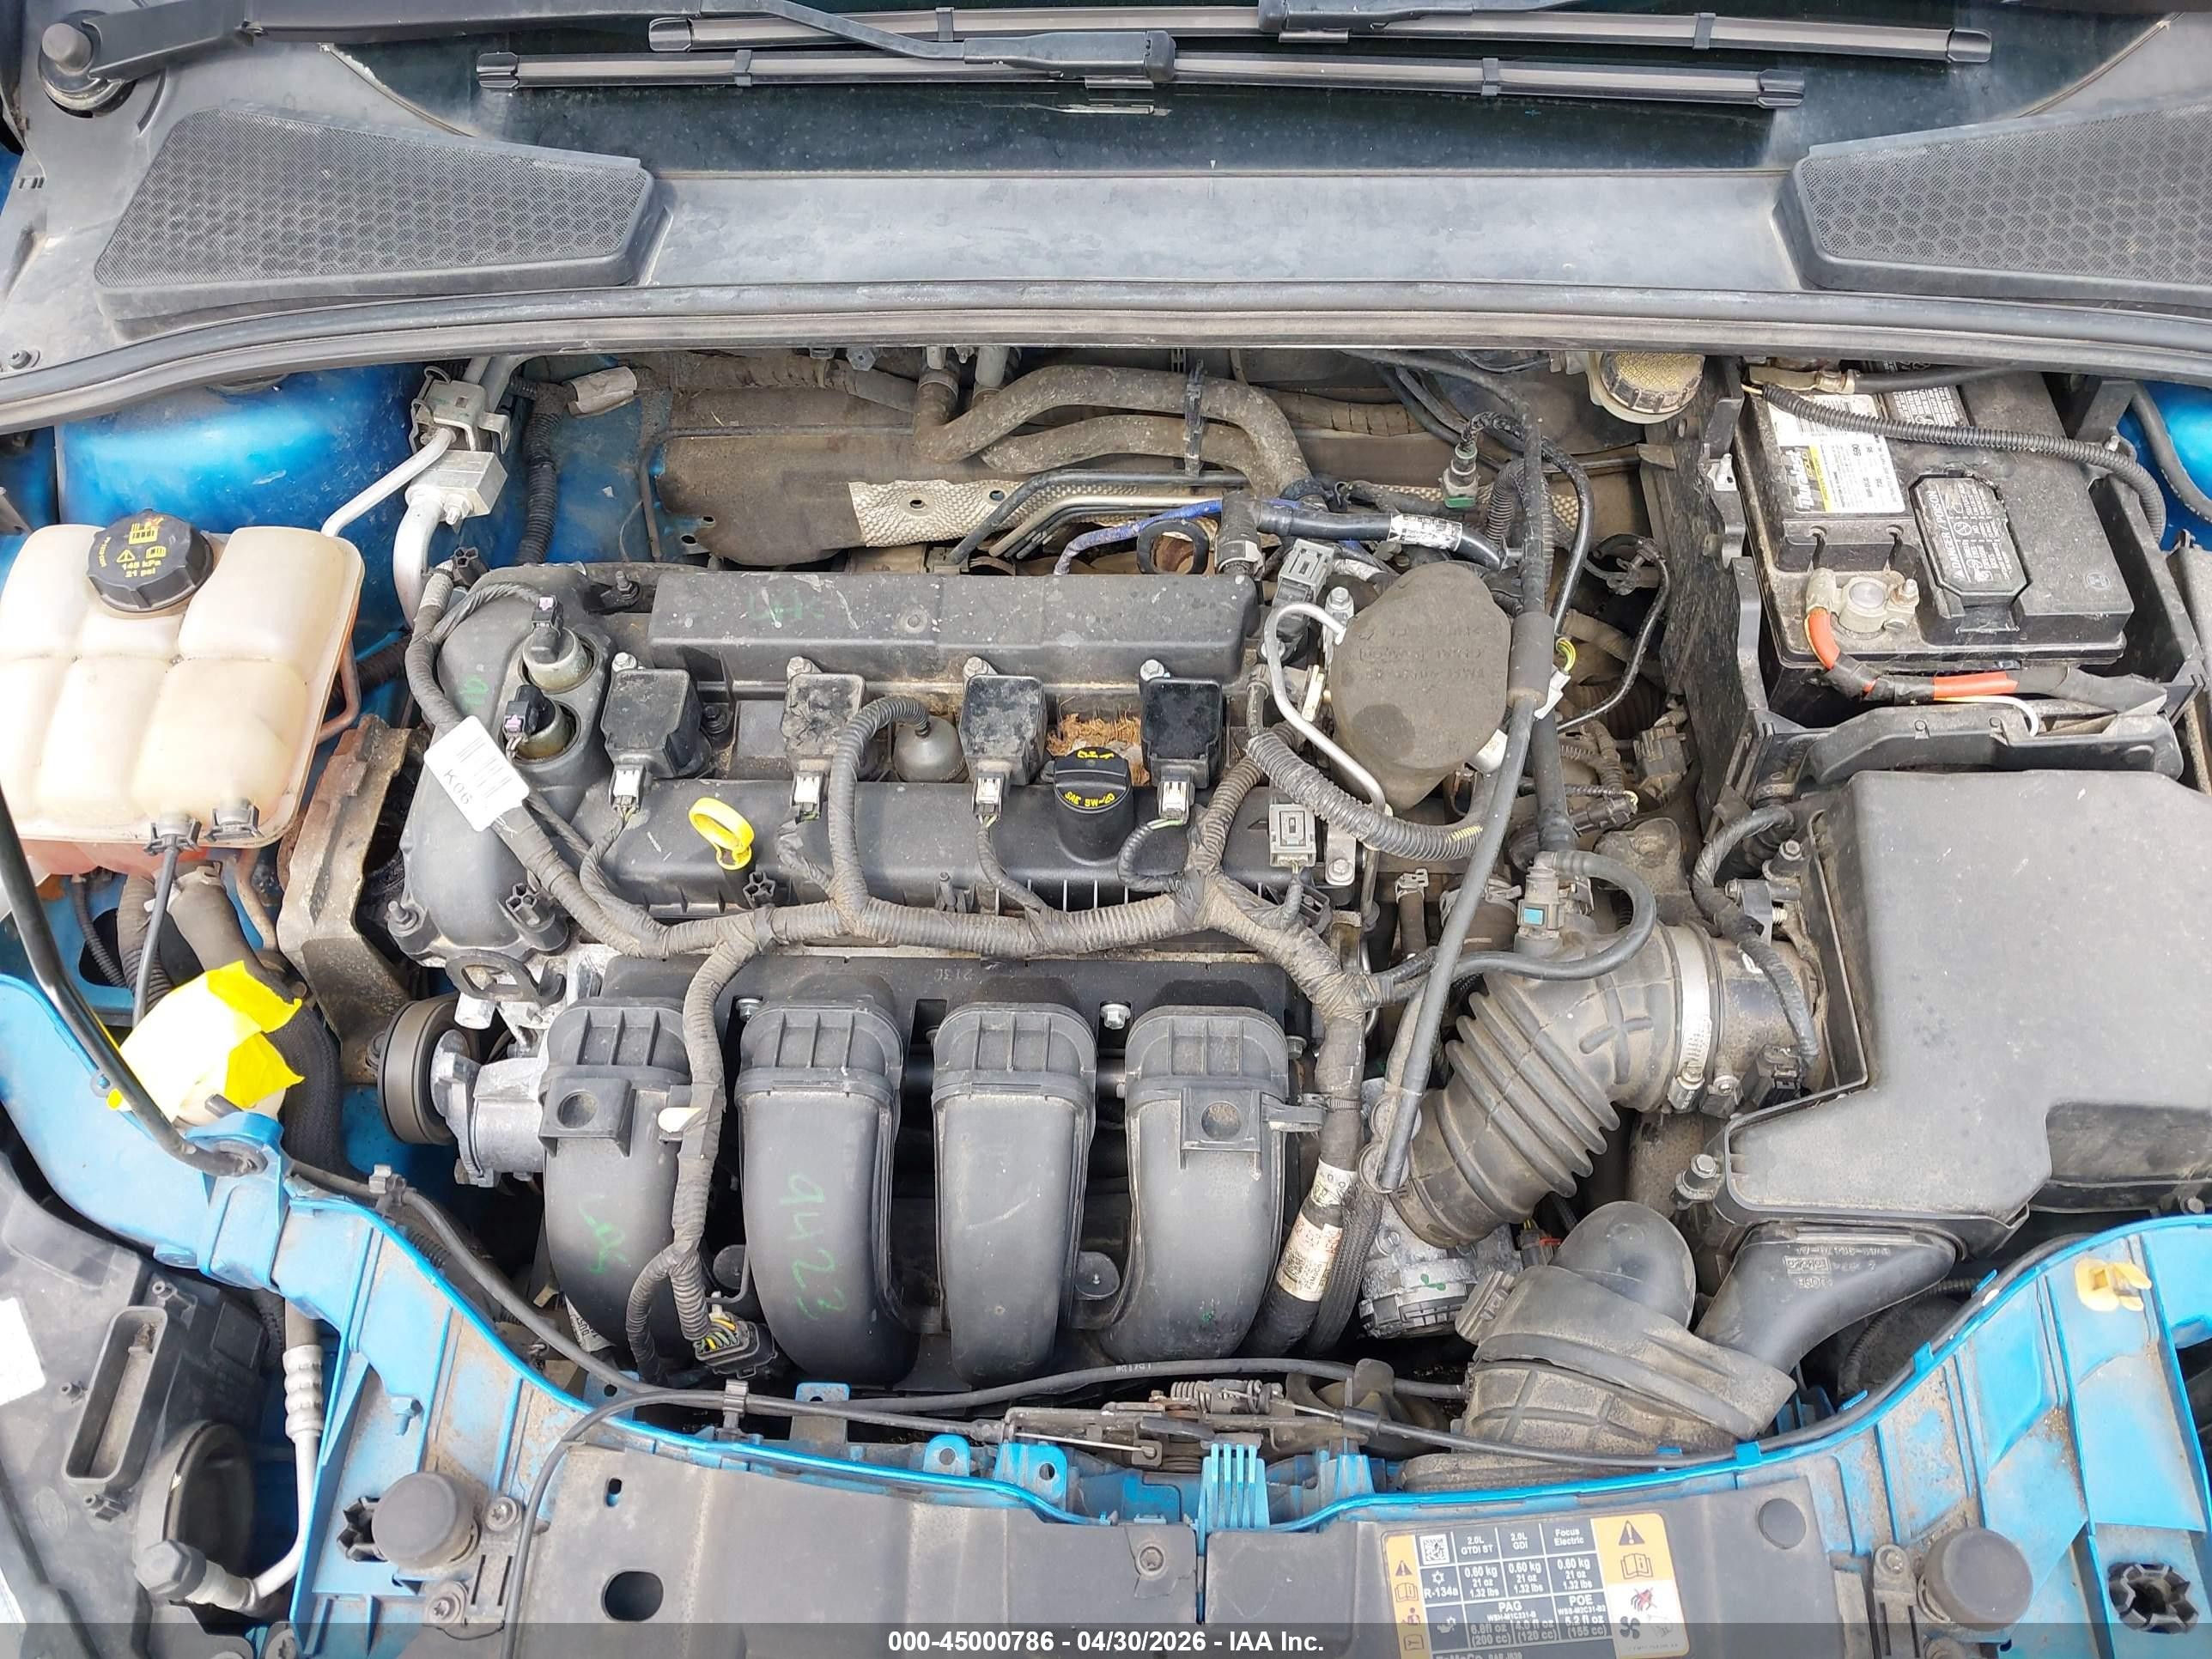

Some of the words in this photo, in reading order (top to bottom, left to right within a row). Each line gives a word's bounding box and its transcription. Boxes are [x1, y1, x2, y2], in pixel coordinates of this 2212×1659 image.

[1801, 451, 1814, 477] GOLD
[1928, 490, 1946, 524] POISON
[1942, 532, 1962, 569] DANGER
[140, 568, 156, 576] psi
[1065, 791, 1081, 805] SAE
[1085, 793, 1115, 807] 5W-20
[1510, 1532, 1528, 1541] 2.0L
[1554, 1528, 1580, 1537] Focus
[1512, 1540, 1528, 1550] GDI
[1554, 1536, 1584, 1547] Electric
[1461, 1546, 1481, 1555] GTDI
[1483, 1545, 1493, 1553] ST
[1509, 1562, 1528, 1573] 0.60
[1529, 1561, 1542, 1573] kg
[1558, 1559, 1577, 1570] 0.60
[1578, 1558, 1590, 1571] kg
[1464, 1566, 1484, 1578] 0.60
[1486, 1565, 1498, 1578] kg
[1565, 1571, 1575, 1580] 21
[1473, 1579, 1482, 1588] 21
[1516, 1575, 1526, 1583] 21
[1563, 1581, 1579, 1590] 1.32
[1581, 1579, 1593, 1589] lbs
[1424, 1587, 1459, 1599] R-134a
[1470, 1589, 1486, 1598] 1.32
[1487, 1588, 1499, 1596] lbs
[1513, 1585, 1529, 1594] 1.32
[1531, 1583, 1543, 1592] lbs
[1569, 1595, 1594, 1606] POE
[1498, 1601, 1522, 1612] PAG
[1592, 1615, 1605, 1624] oz
[1517, 1631, 1539, 1643] (120
[1540, 1630, 1559, 1641] cc)
[1567, 1627, 1589, 1638] (155
[1590, 1625, 1607, 1637] cc)
[1471, 1635, 1493, 1648] (200
[1495, 1633, 1511, 1645] cc)
